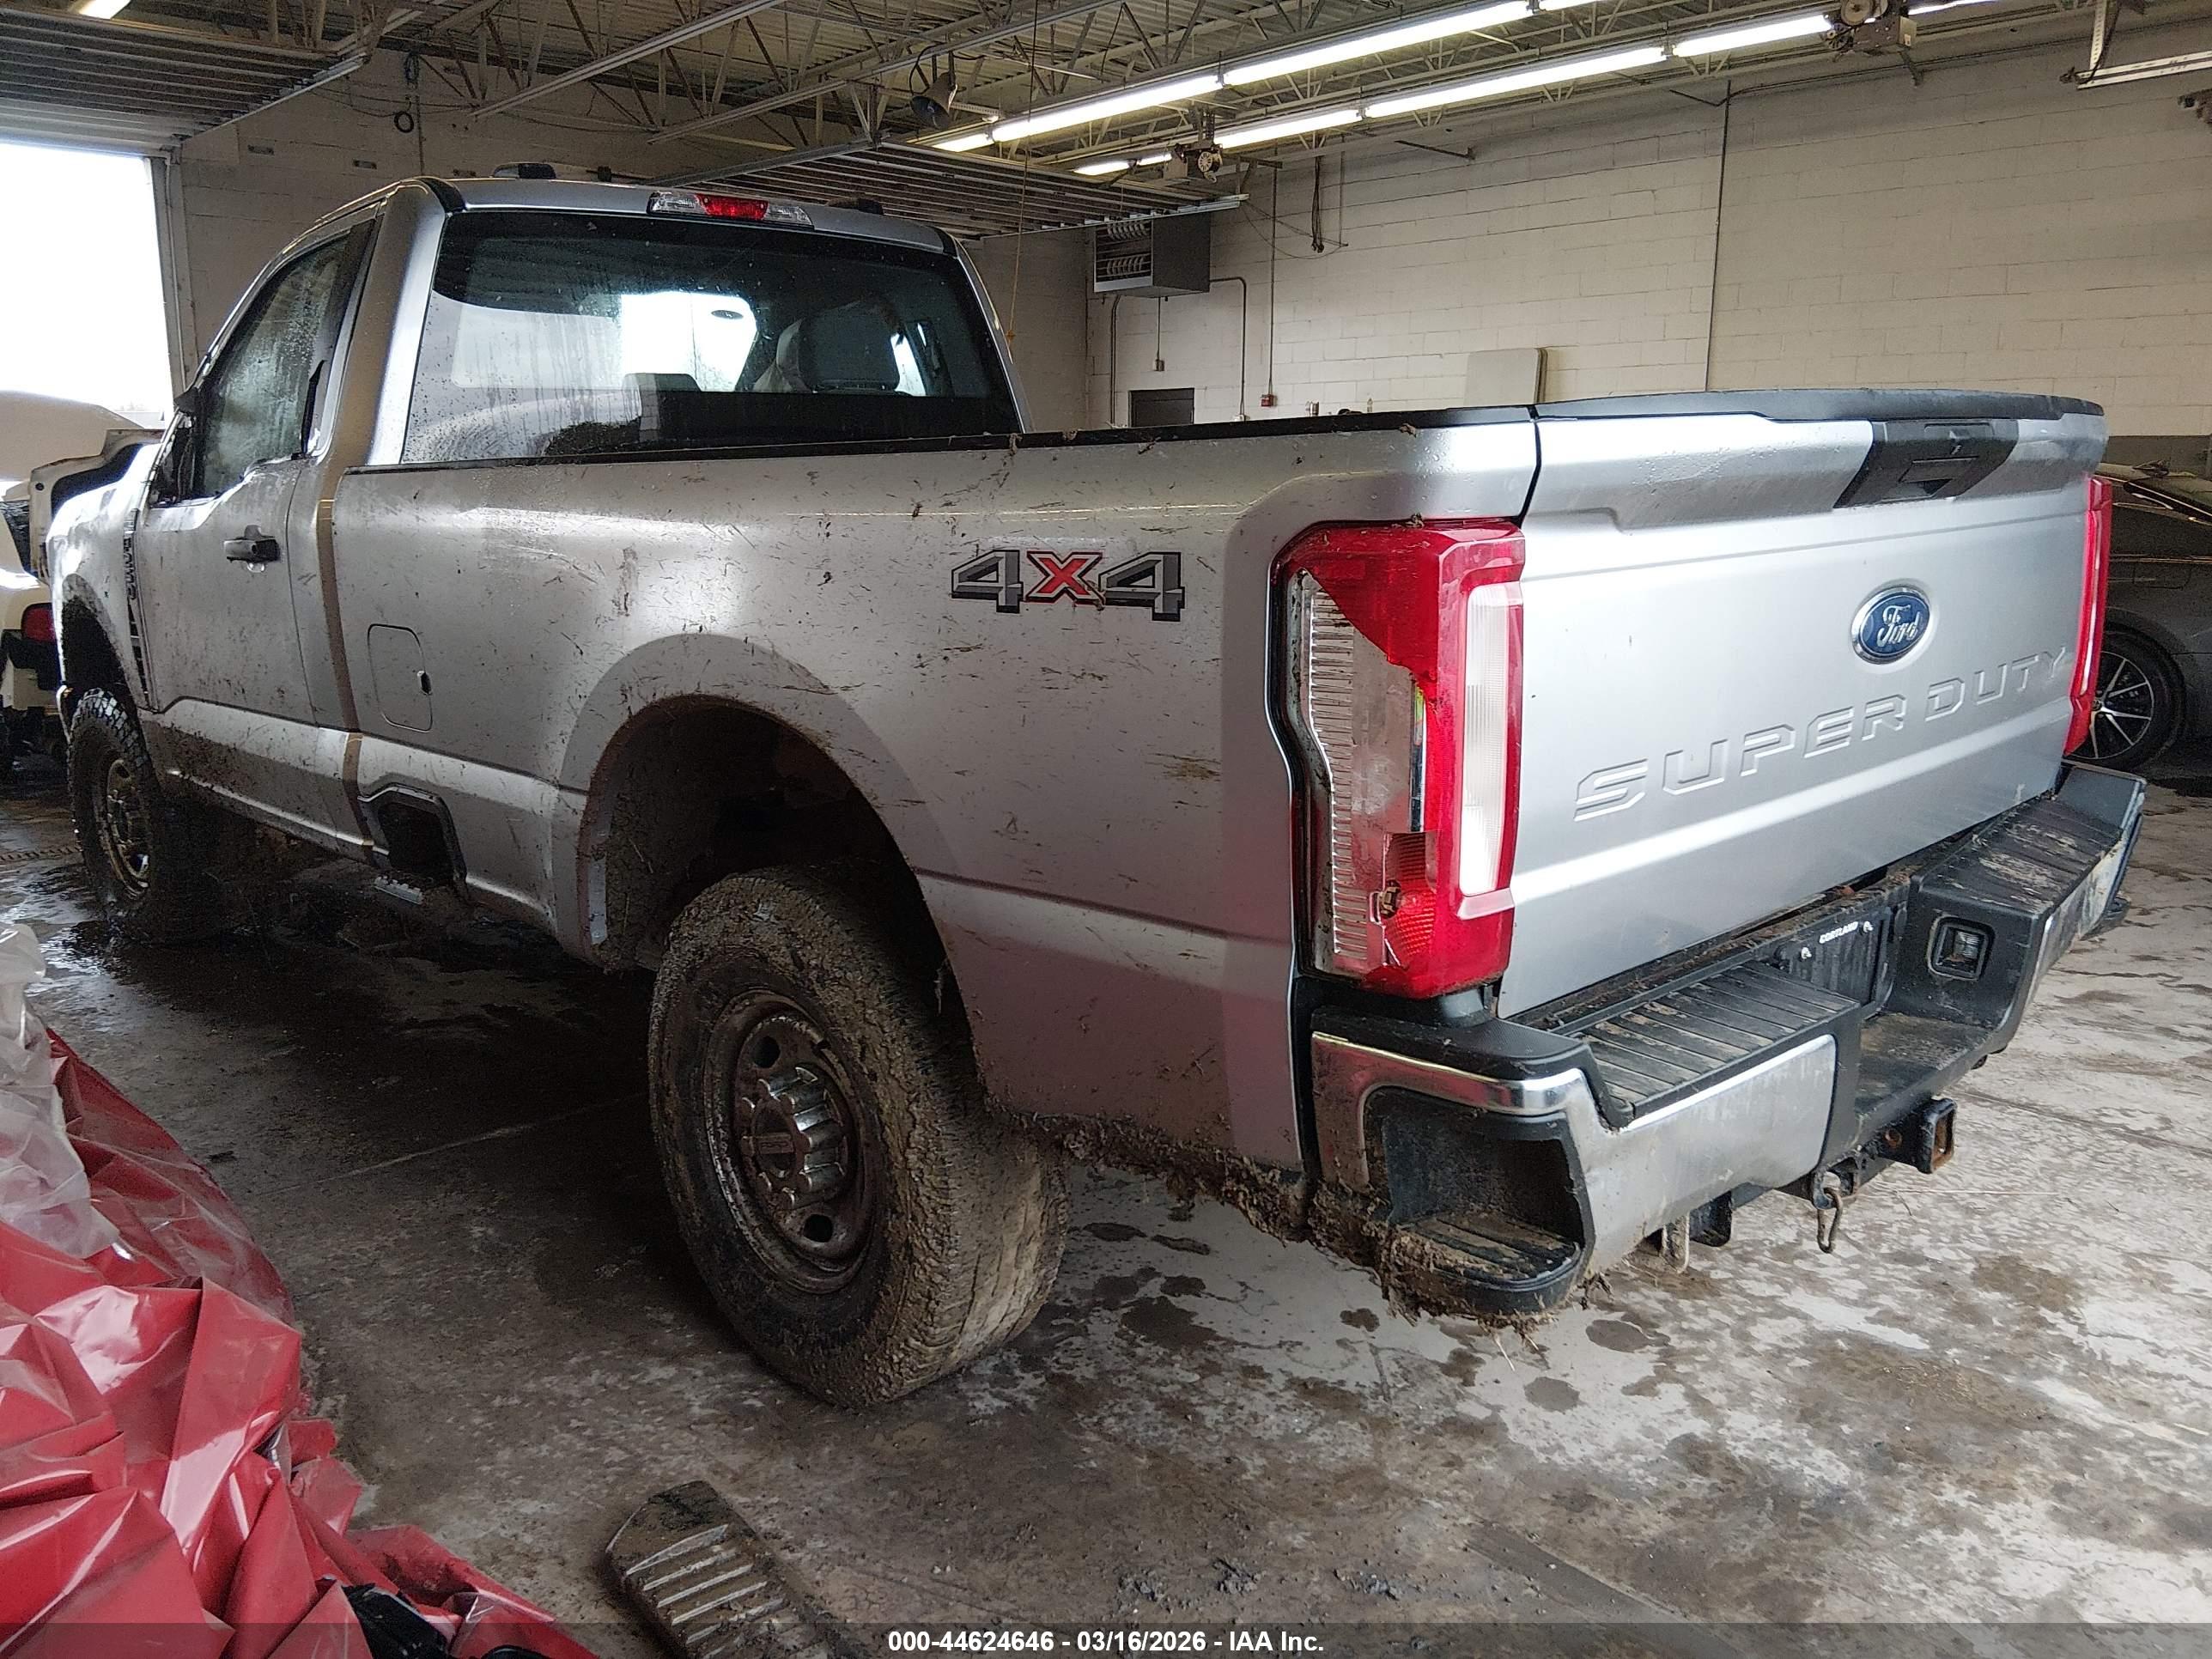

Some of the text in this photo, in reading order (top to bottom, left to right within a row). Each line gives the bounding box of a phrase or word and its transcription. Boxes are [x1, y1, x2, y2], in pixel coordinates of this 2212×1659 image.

[1876, 604, 1924, 647] Ford
[1572, 646, 2067, 823] SUPER DUTY
